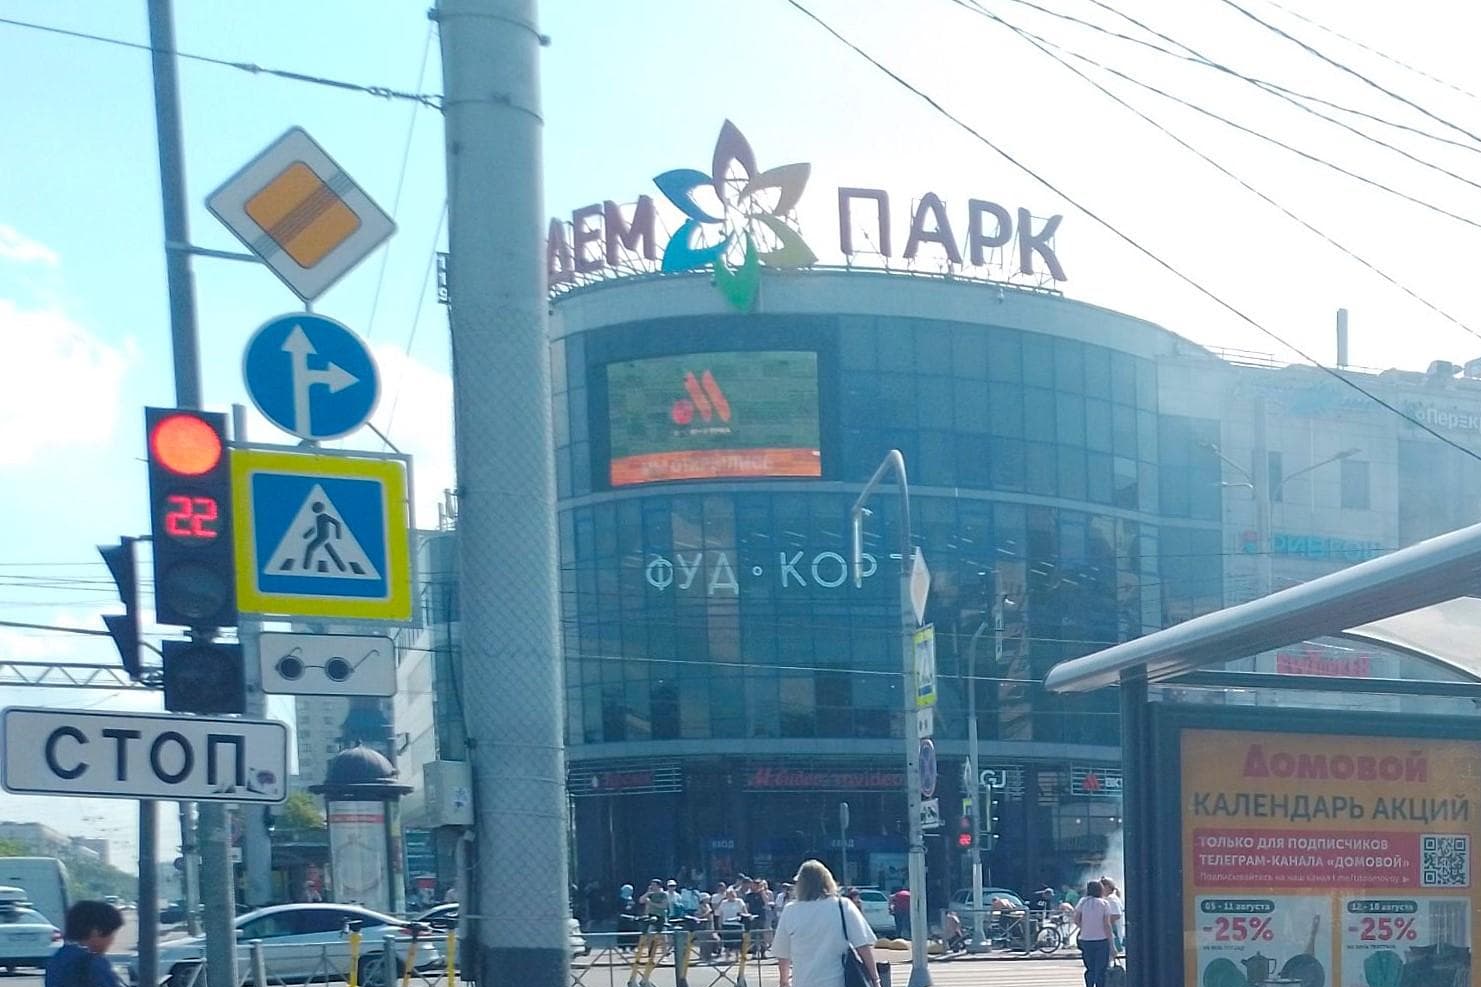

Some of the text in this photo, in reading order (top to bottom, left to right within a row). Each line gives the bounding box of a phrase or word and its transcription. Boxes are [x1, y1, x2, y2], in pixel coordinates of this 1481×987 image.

[838, 187, 1067, 282] ПАРК
[165, 495, 218, 538] 22
[645, 551, 740, 596] ФУД
[44, 726, 246, 787] СТОП
[1193, 792, 1470, 824] КАЛЕНДАРЬ АКЦИЙ
[1199, 836, 1389, 851] ТОЛЬКО ДЛЯ ПОДПИСЧИКОВ
[1199, 853, 1411, 870] ТЕЛЕГРАМ-КАНАЛА «ДОМОВОЙ»
[1202, 916, 1274, 942] -25%
[1347, 917, 1417, 942] -25%
